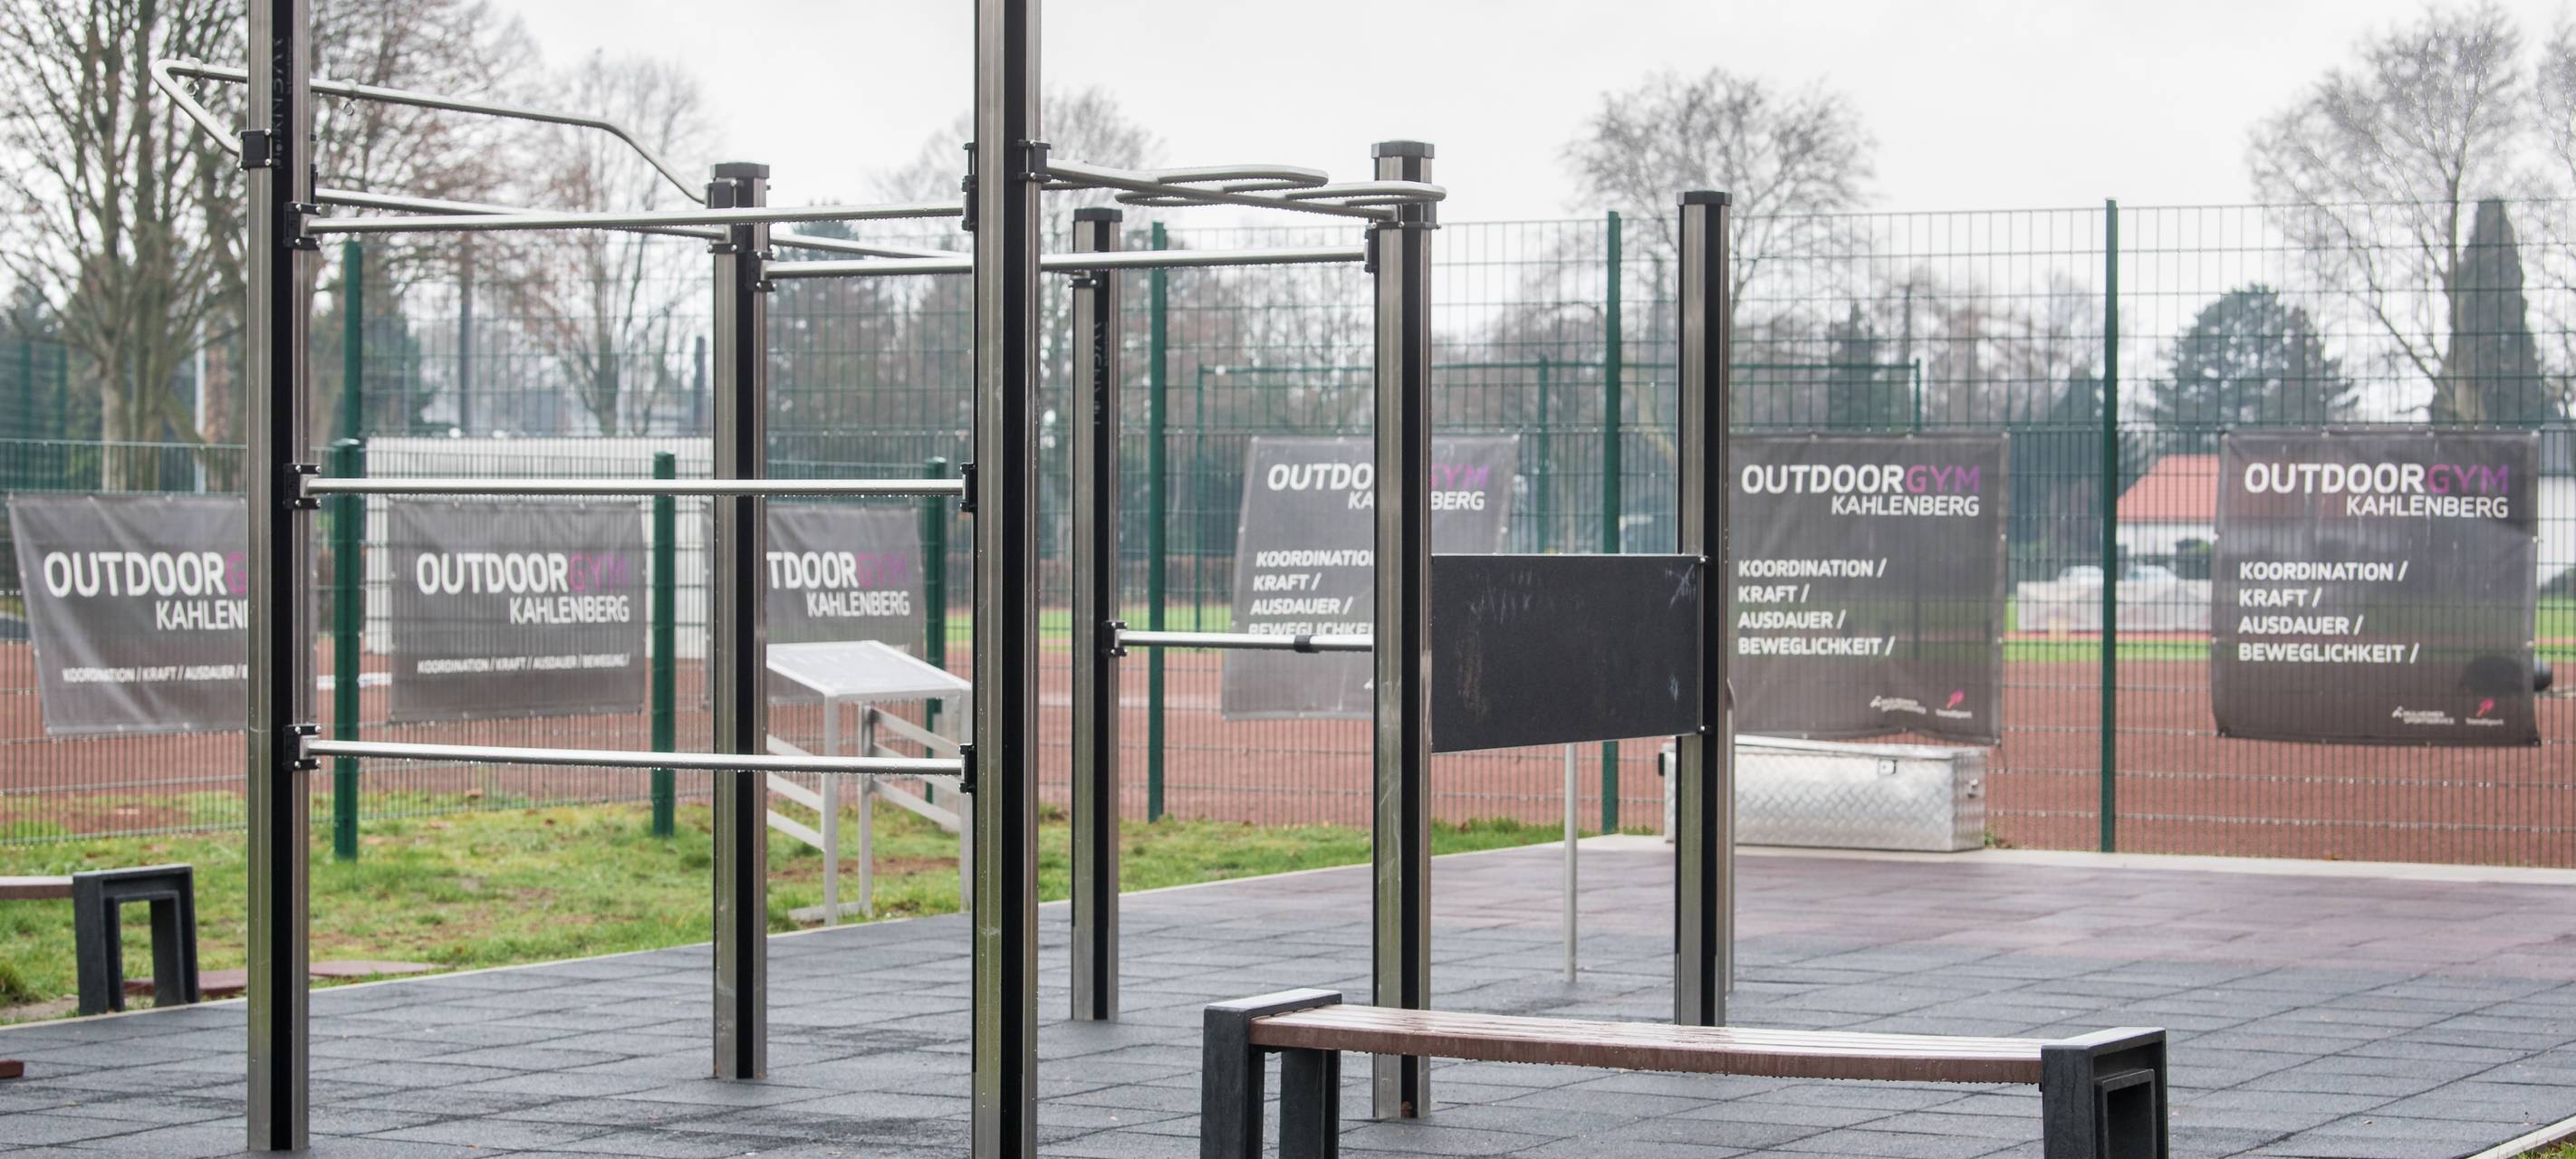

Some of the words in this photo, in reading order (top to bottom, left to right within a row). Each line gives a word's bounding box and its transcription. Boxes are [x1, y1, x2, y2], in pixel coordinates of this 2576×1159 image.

[1268, 463, 1488, 491] OUTDOYM
[1741, 465, 1981, 493] OUTDOORGYM
[2244, 463, 2508, 494] OUTDOORGYM
[1831, 495, 1980, 517] KAHLENBERG
[2346, 495, 2509, 519] KAHLENBERG
[416, 551, 629, 595] OUTDOORGYM
[1738, 560, 1873, 578] KOORDINATION
[1877, 558, 1887, 579] /
[2239, 561, 2394, 580] KOORDINATION
[2398, 560, 2408, 581] /
[1253, 573, 1310, 591] KRAFT
[1311, 572, 1322, 590] /
[806, 590, 910, 618] KAHLENBERG
[1738, 586, 1797, 603] KRAFT
[1800, 584, 1810, 603] /
[2238, 589, 2308, 608] KRAFT
[2312, 587, 2322, 608] /
[509, 595, 630, 624] KAHLENBERG
[1250, 598, 1341, 616] AUSDAUER
[1342, 596, 1353, 615] /
[1738, 611, 1833, 628] AUSDAUER
[1836, 609, 1846, 629] /
[2237, 616, 2350, 635] AUSDAUER
[2353, 615, 2364, 636] /
[1738, 637, 1882, 656] BEWEGLICHKEIT
[1885, 636, 1896, 656] /
[2238, 643, 2406, 664] BEWEGLICHKEIT
[2409, 642, 2420, 665] /
[142, 666, 177, 681] KRAFT
